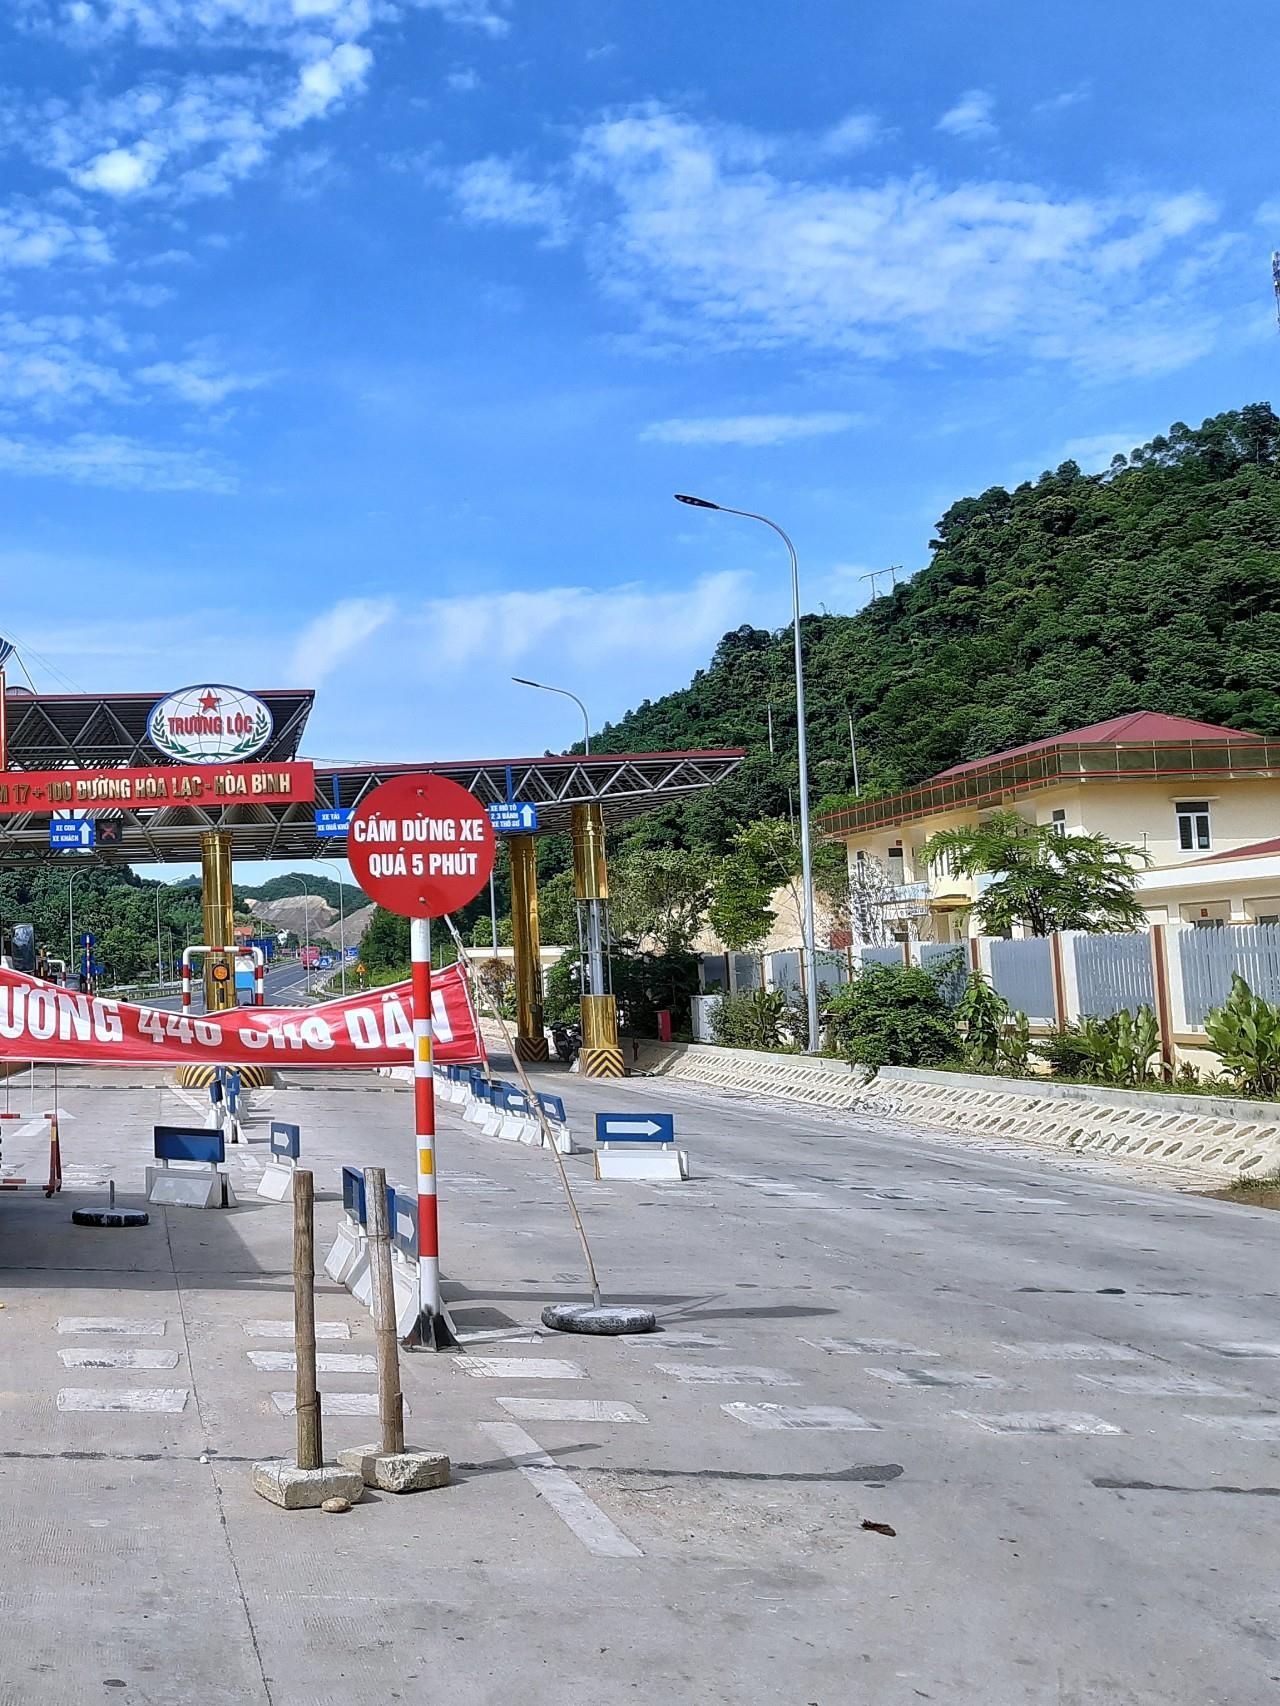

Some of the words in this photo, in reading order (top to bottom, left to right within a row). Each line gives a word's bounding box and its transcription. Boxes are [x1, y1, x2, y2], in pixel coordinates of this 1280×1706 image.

[167, 712, 224, 736] TRƯỜNG
[226, 712, 254, 738] LỘC
[13, 784, 29, 803] 17
[47, 781, 72, 801] 100
[77, 775, 131, 800] ĐƯỜNG
[135, 773, 167, 798] HÒA
[172, 776, 202, 802] LẠC
[215, 769, 247, 796] HÒA
[251, 770, 291, 795] BÌNH
[354, 812, 396, 842] CẤM
[402, 813, 455, 842] DỪNG
[460, 819, 484, 841] XE
[368, 847, 407, 878] QUÁ
[412, 853, 423, 876] 5
[429, 847, 478, 876] PHÚT
[344, 989, 454, 1050] DÂN
